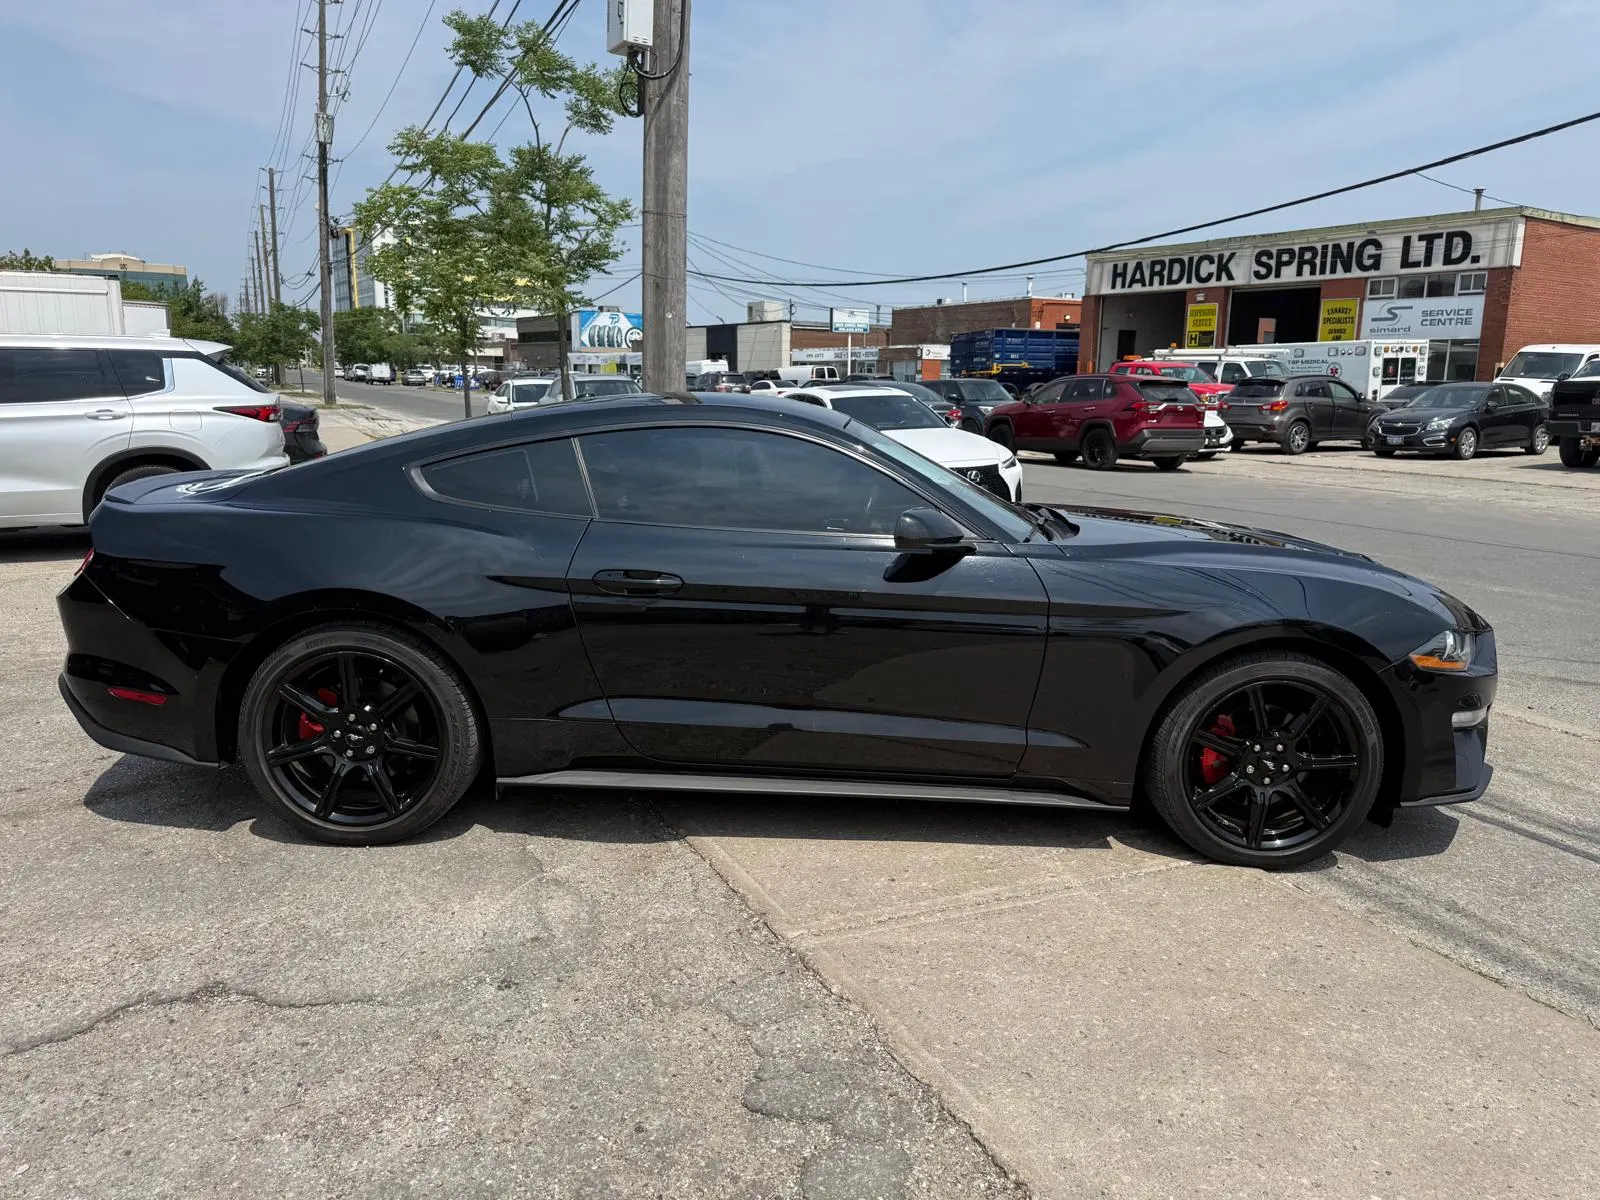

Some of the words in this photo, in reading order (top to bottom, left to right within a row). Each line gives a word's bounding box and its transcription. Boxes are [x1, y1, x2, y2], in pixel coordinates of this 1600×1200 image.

[1110, 251, 1237, 290] HARDICK
[1252, 237, 1383, 281] SPRING
[1399, 230, 1481, 269] LTD.
[1327, 306, 1352, 315] EXHAUST
[1421, 308, 1473, 318] SERVICE
[1322, 316, 1354, 325] SPECIALISTS
[1420, 317, 1473, 327] CENTRE
[1369, 326, 1411, 334] simard
[1189, 333, 1198, 345] H
